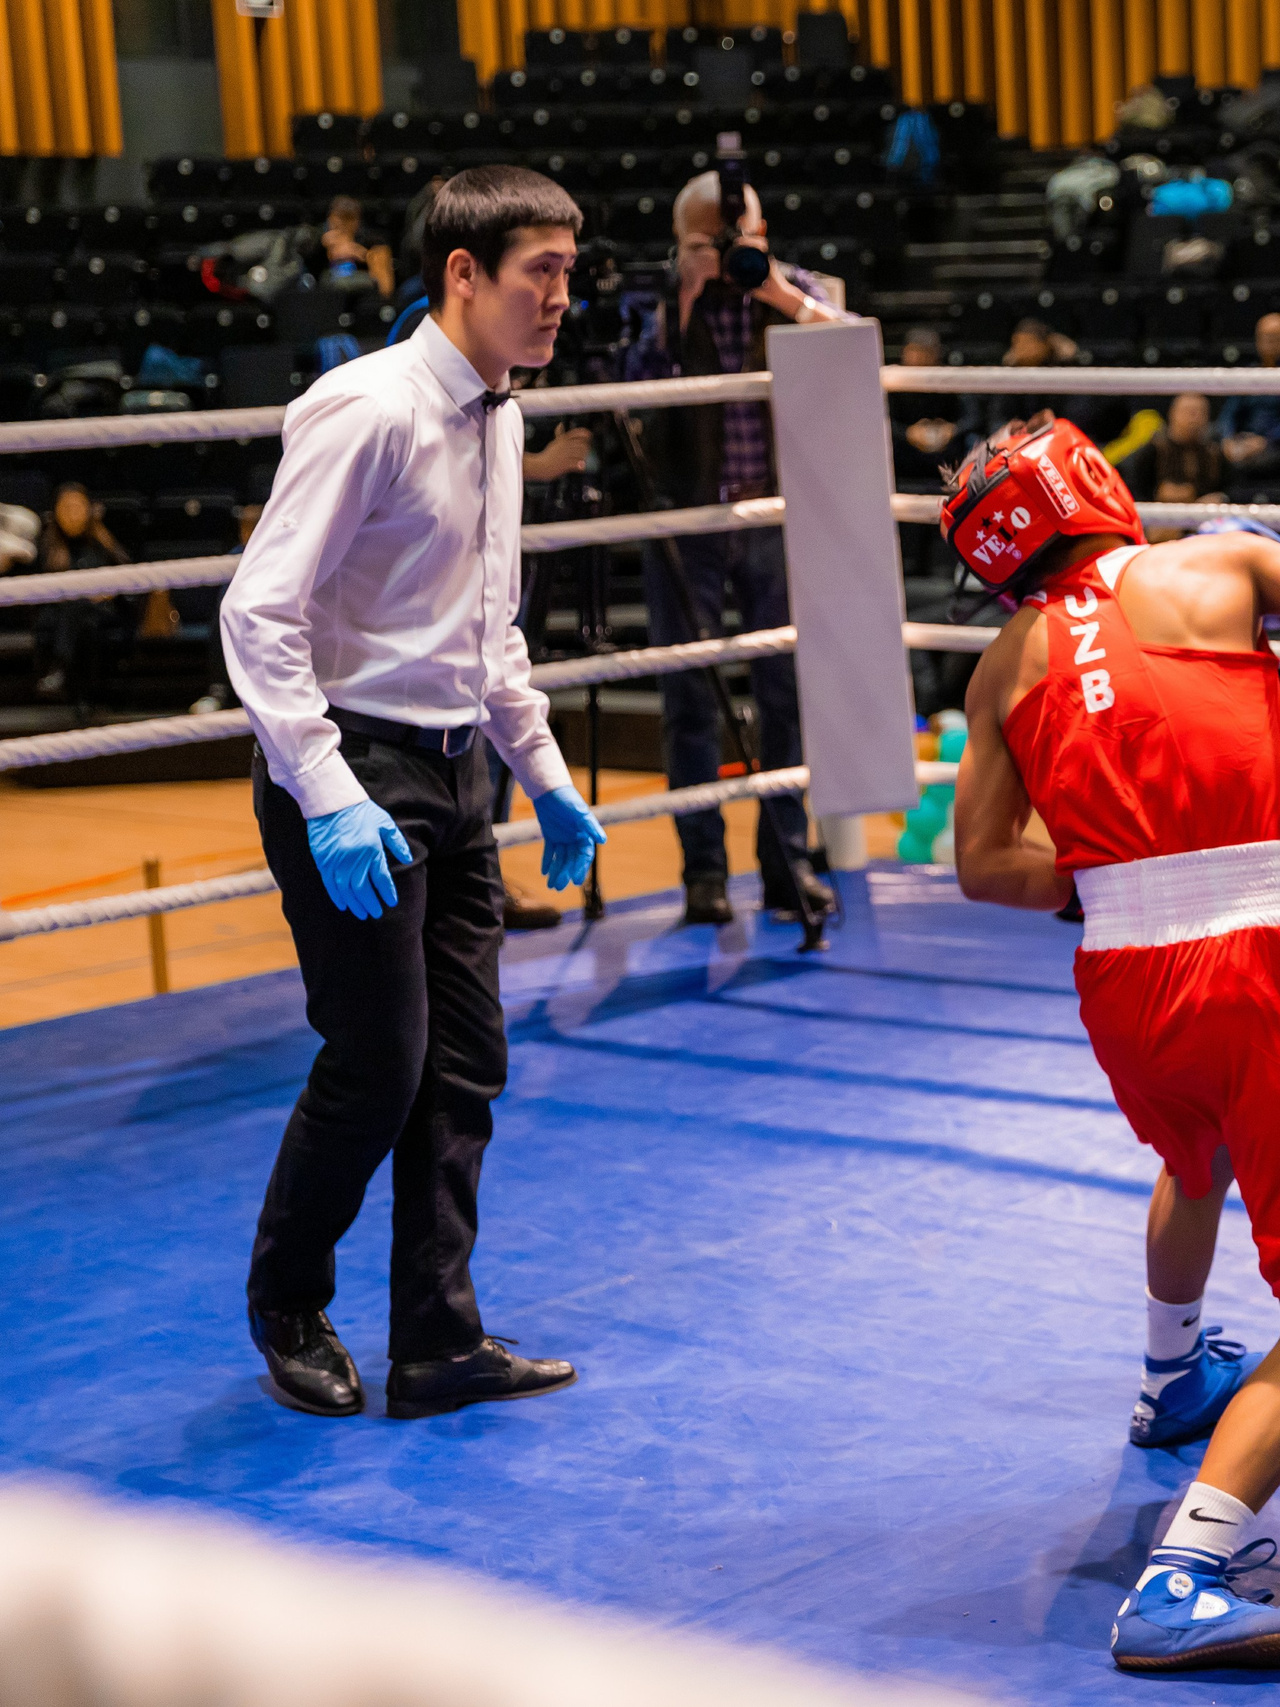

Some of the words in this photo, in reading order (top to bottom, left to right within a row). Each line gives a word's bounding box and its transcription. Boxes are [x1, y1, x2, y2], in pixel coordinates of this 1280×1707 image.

[1040, 453, 1076, 511] VELO
[972, 506, 1031, 565] VELO
[1064, 586, 1115, 713] UZB
